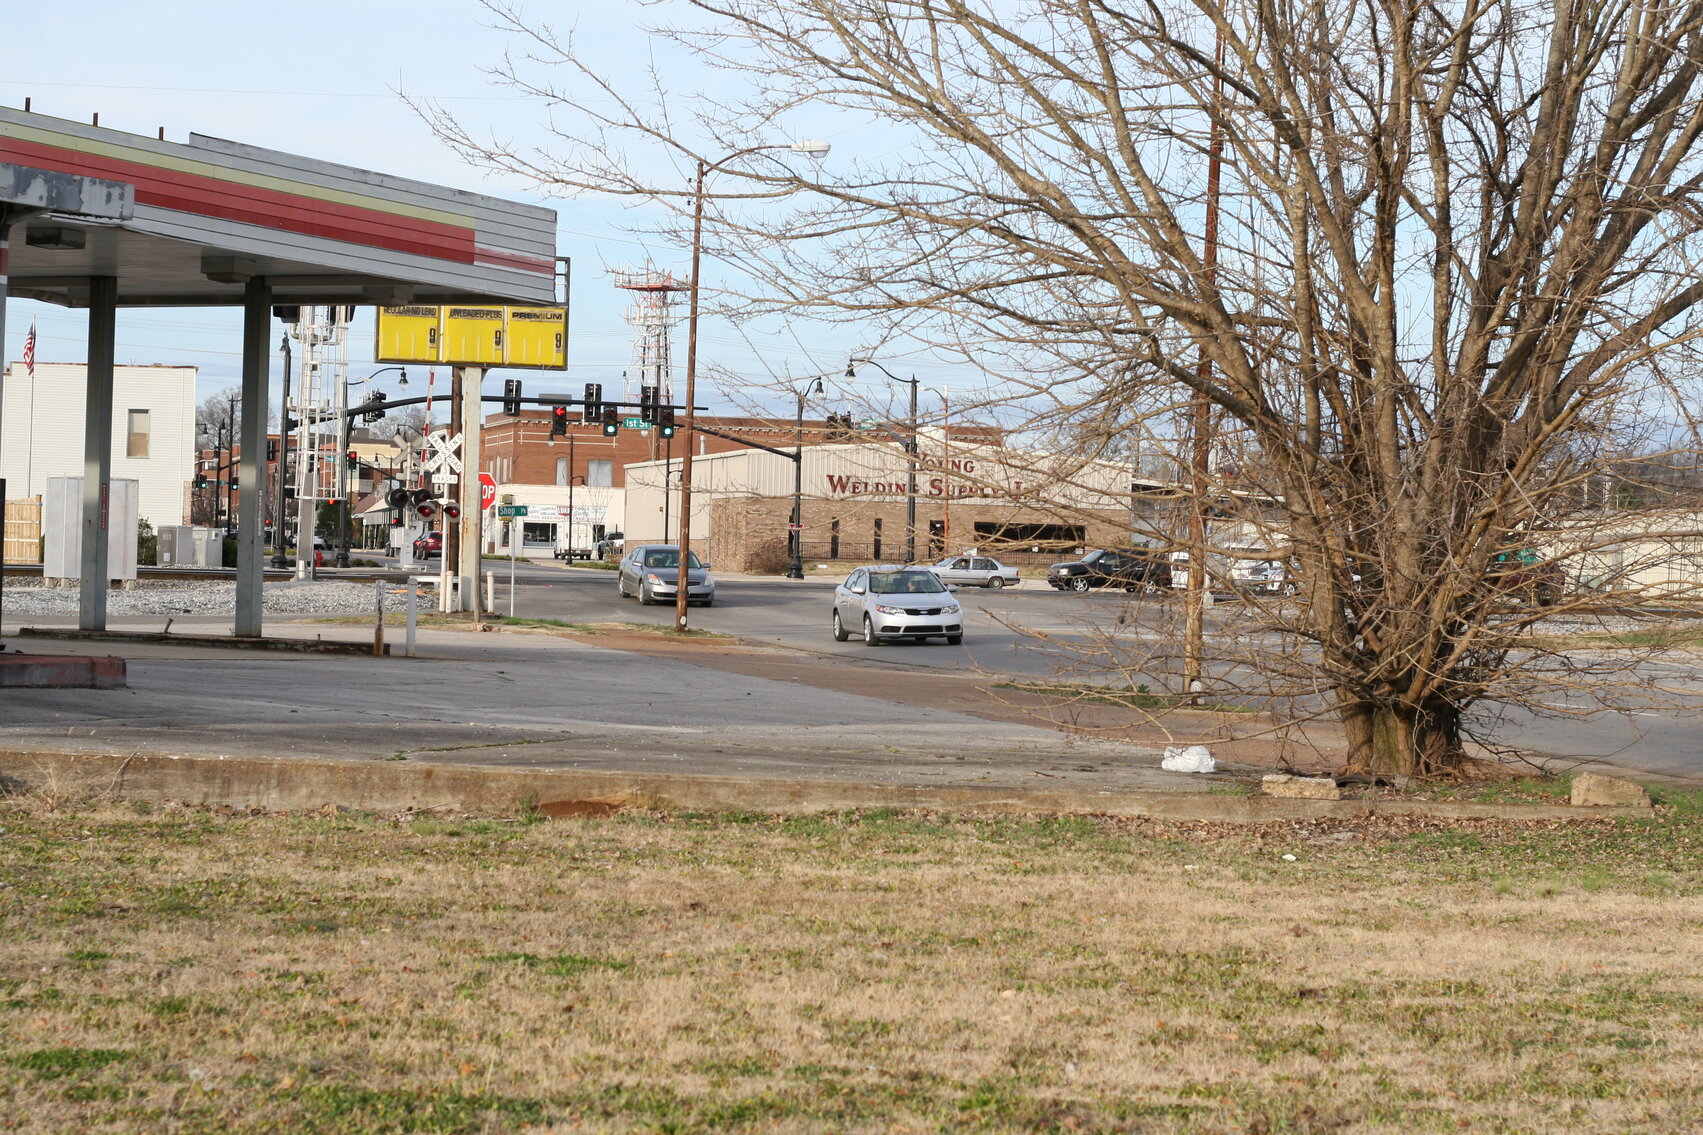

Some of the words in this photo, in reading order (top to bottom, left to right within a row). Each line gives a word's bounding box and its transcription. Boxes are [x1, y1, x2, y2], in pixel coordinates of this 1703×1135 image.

[512, 311, 562, 320] PREMIUM
[429, 328, 436, 344] 9
[495, 330, 501, 346] 9
[555, 333, 562, 348] 9
[626, 419, 637, 427] 1st
[428, 434, 463, 470] CROSSING
[429, 433, 462, 471] RAILROAD
[482, 485, 495, 499] OP
[500, 506, 516, 515] Shop
